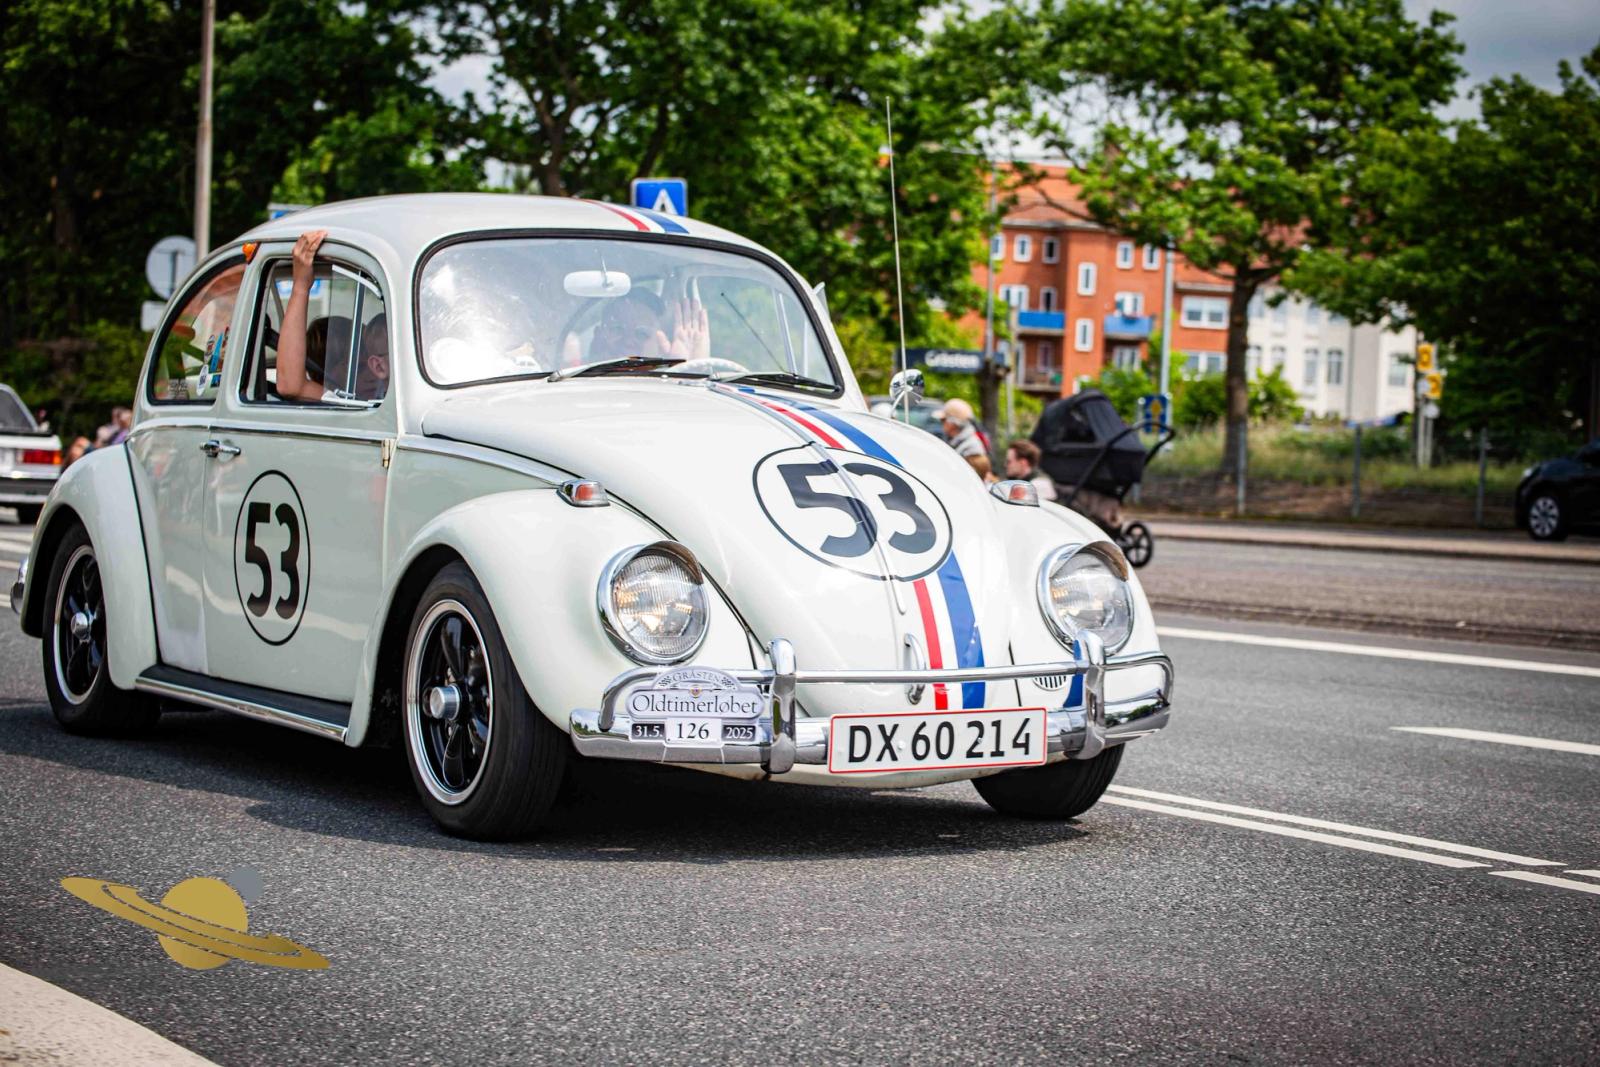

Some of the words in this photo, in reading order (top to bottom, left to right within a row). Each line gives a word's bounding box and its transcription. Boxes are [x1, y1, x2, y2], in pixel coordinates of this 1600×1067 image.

[777, 459, 936, 557] 53
[245, 501, 300, 619] 53
[672, 669, 721, 682] GRÅSTEN
[632, 694, 758, 713] Oldtimerløbet
[677, 722, 709, 740] 126
[725, 726, 753, 739] 2025
[848, 723, 900, 763] DX
[911, 720, 955, 761] 60
[966, 717, 1031, 758] 214
